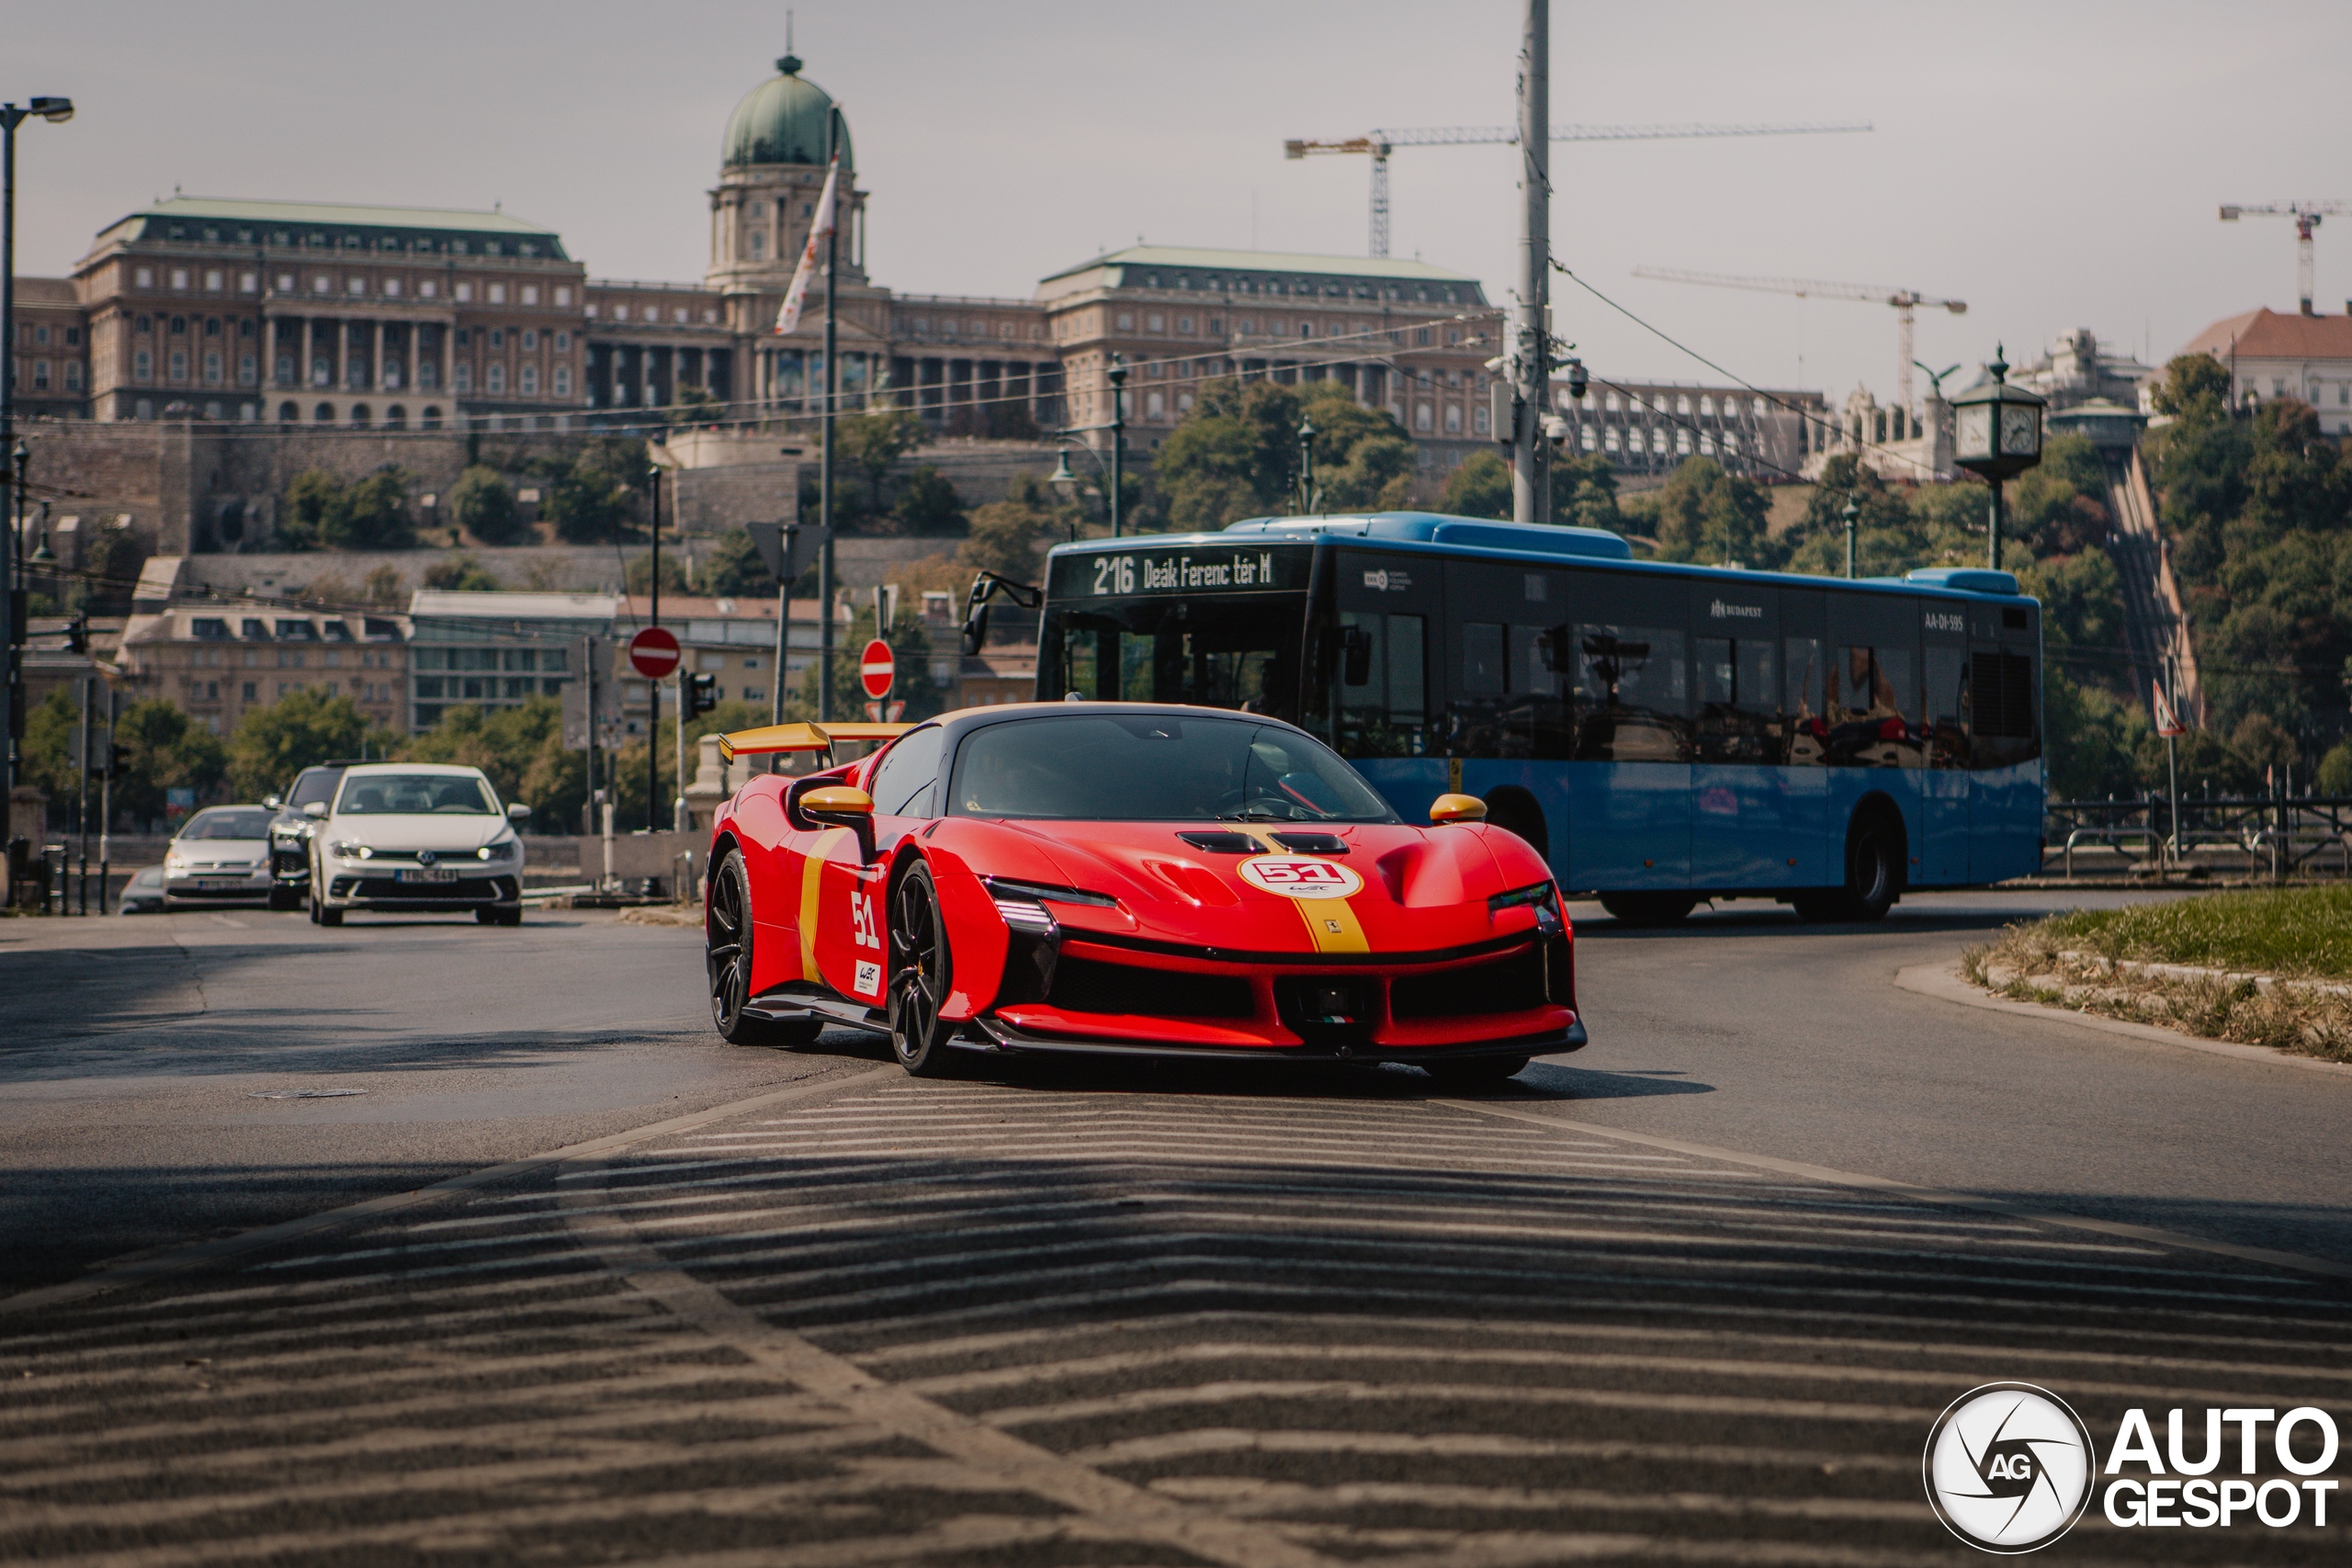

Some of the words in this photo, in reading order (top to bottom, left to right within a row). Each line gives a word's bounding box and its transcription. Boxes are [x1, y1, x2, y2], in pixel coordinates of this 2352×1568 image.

[1094, 556, 1135, 595] 216
[1144, 557, 1177, 589] Deák
[1181, 557, 1229, 587] Ferenc
[1233, 554, 1256, 584] tér
[1260, 553, 1272, 583] M
[1726, 604, 1762, 618] BUDAPEST
[1256, 863, 1344, 882] 51
[851, 890, 880, 949] 51
[859, 966, 876, 981] WEC
